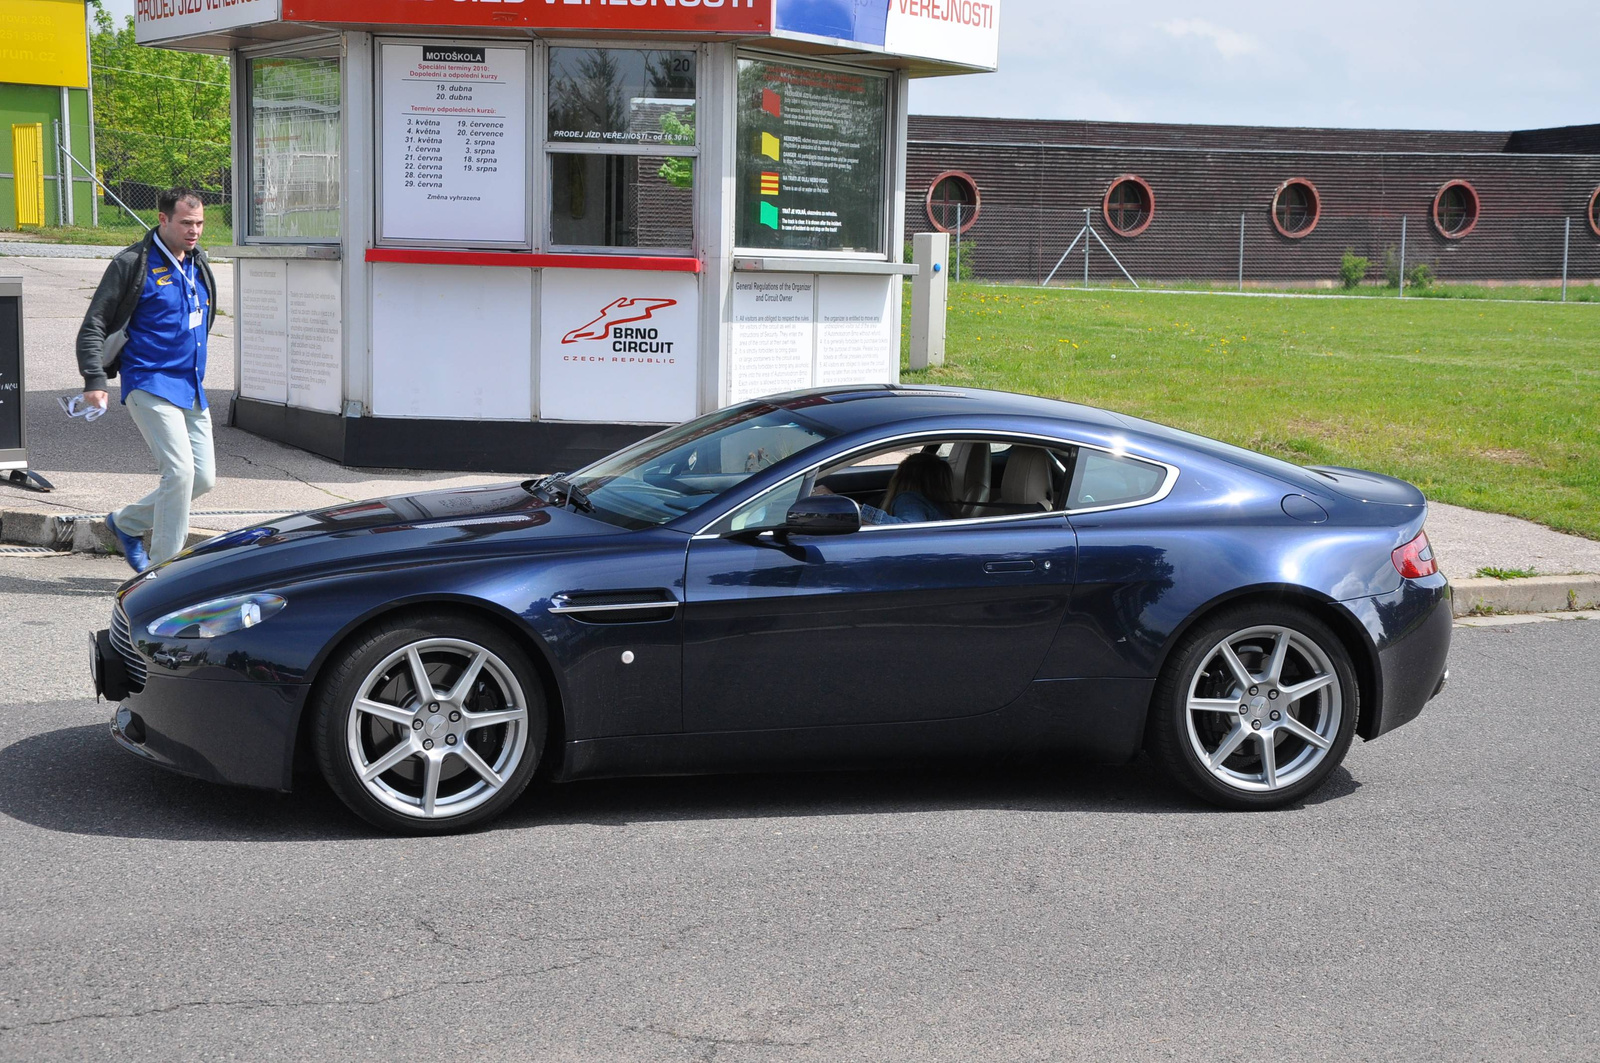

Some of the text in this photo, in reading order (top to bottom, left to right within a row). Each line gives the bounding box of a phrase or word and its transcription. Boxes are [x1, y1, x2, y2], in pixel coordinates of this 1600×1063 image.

[138, 0, 174, 22] PRODEJ
[0, 14, 28, 24] rova
[0, 48, 56, 62] rum.cz
[426, 51, 482, 62] MOTOŠKOLA
[673, 58, 690, 72] 20
[585, 130, 601, 138] JÍZD
[602, 131, 648, 140] VEŘEJNOSTI
[735, 282, 753, 290] General
[754, 282, 778, 292] Regulations
[792, 283, 812, 292] Organizer
[613, 327, 658, 340] BRNO
[612, 341, 674, 353] CIRCUIT
